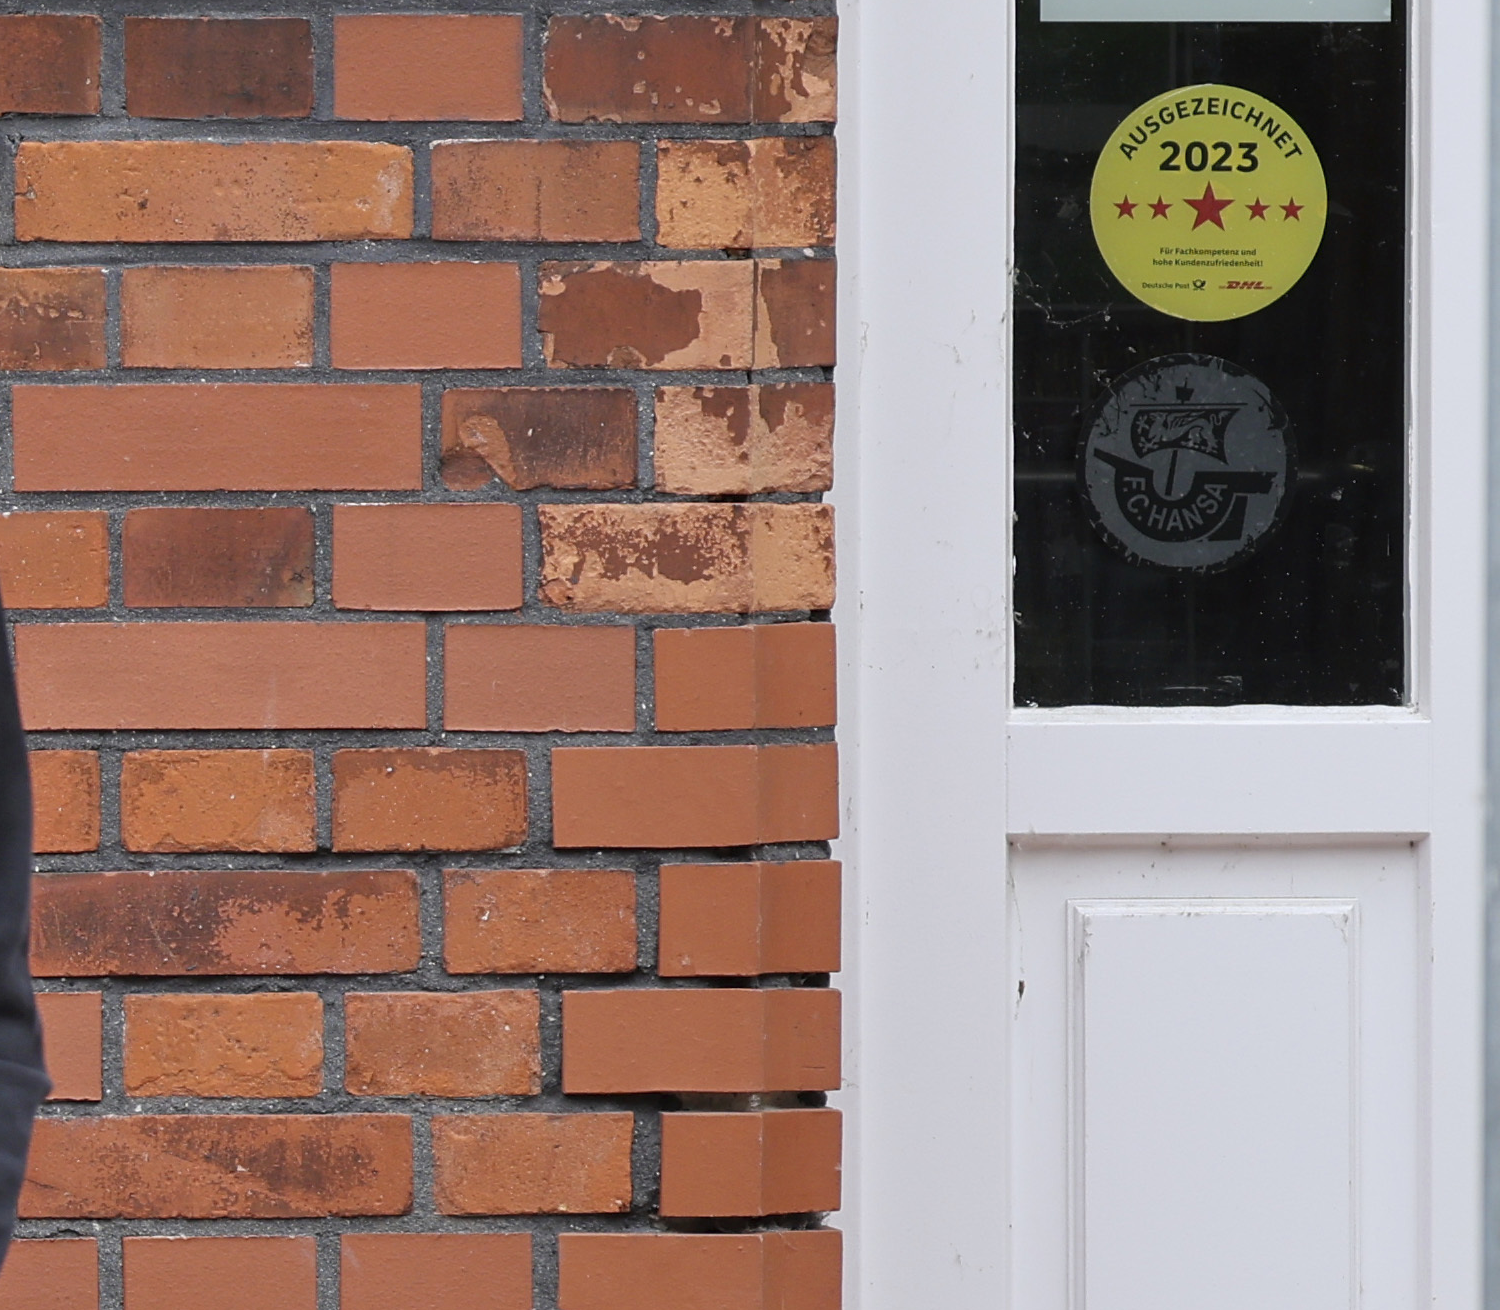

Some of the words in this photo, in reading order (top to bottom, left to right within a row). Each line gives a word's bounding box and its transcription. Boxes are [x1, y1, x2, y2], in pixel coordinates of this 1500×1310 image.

[1119, 97, 1304, 161] AUSGEZEICHNET
[1159, 140, 1259, 173] 2023
[1159, 247, 1174, 255] Für
[1174, 247, 1240, 257] Fachkompetenz
[1240, 248, 1257, 256] und
[1152, 258, 1174, 267] hohe
[1174, 258, 1263, 268] Kundenzufriedenheit!
[1141, 281, 1174, 289] Deutsche
[1174, 282, 1190, 290] Post
[1225, 280, 1266, 290] DHL
[1147, 483, 1229, 532] HANSA
